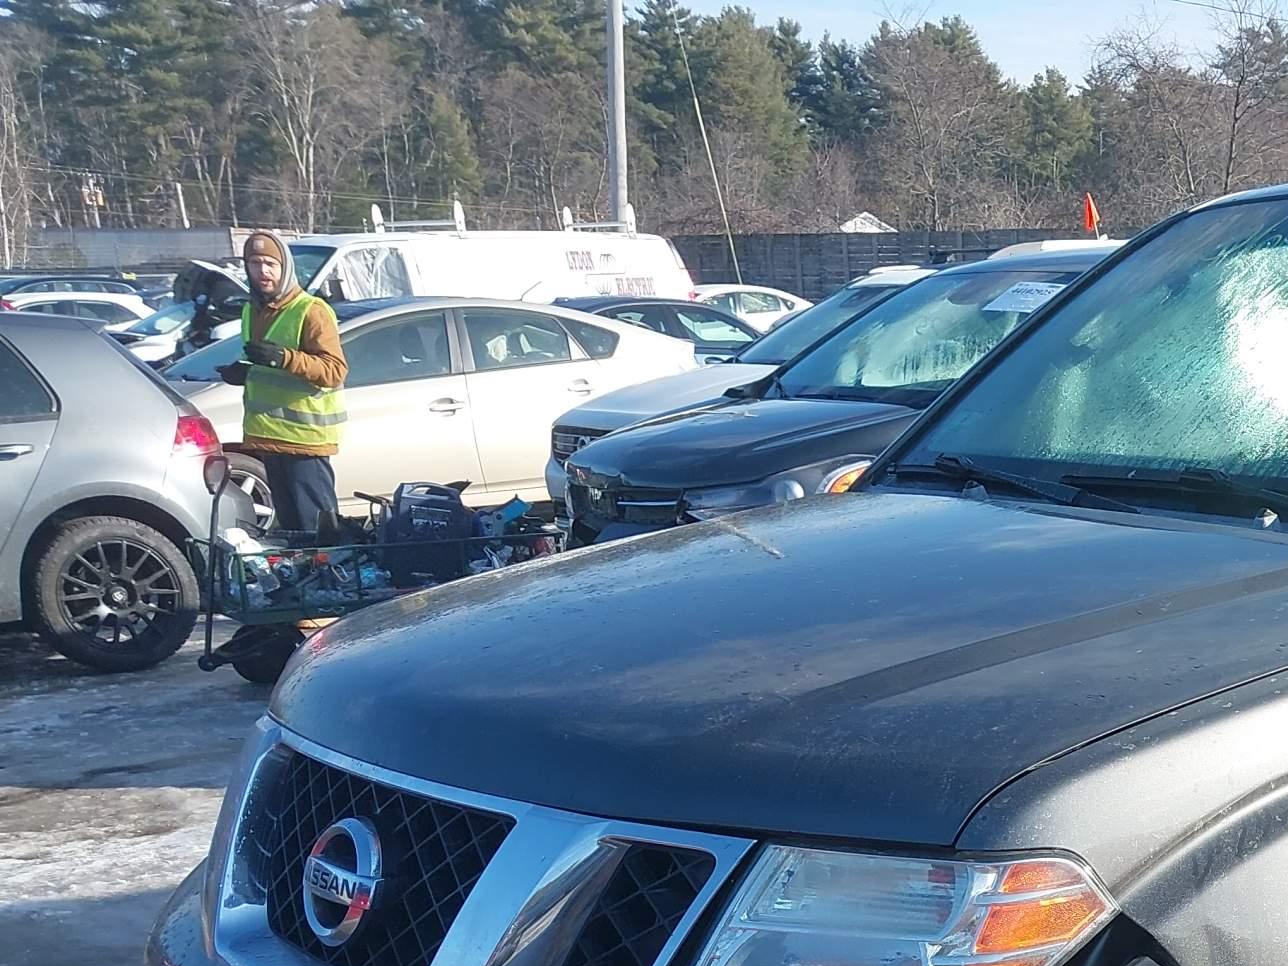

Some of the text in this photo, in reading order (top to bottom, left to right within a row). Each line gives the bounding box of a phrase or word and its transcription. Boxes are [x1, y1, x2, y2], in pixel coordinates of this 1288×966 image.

[565, 251, 595, 271] LYDON
[615, 277, 656, 296] ELECTRIC
[310, 868, 356, 899] SSAN
